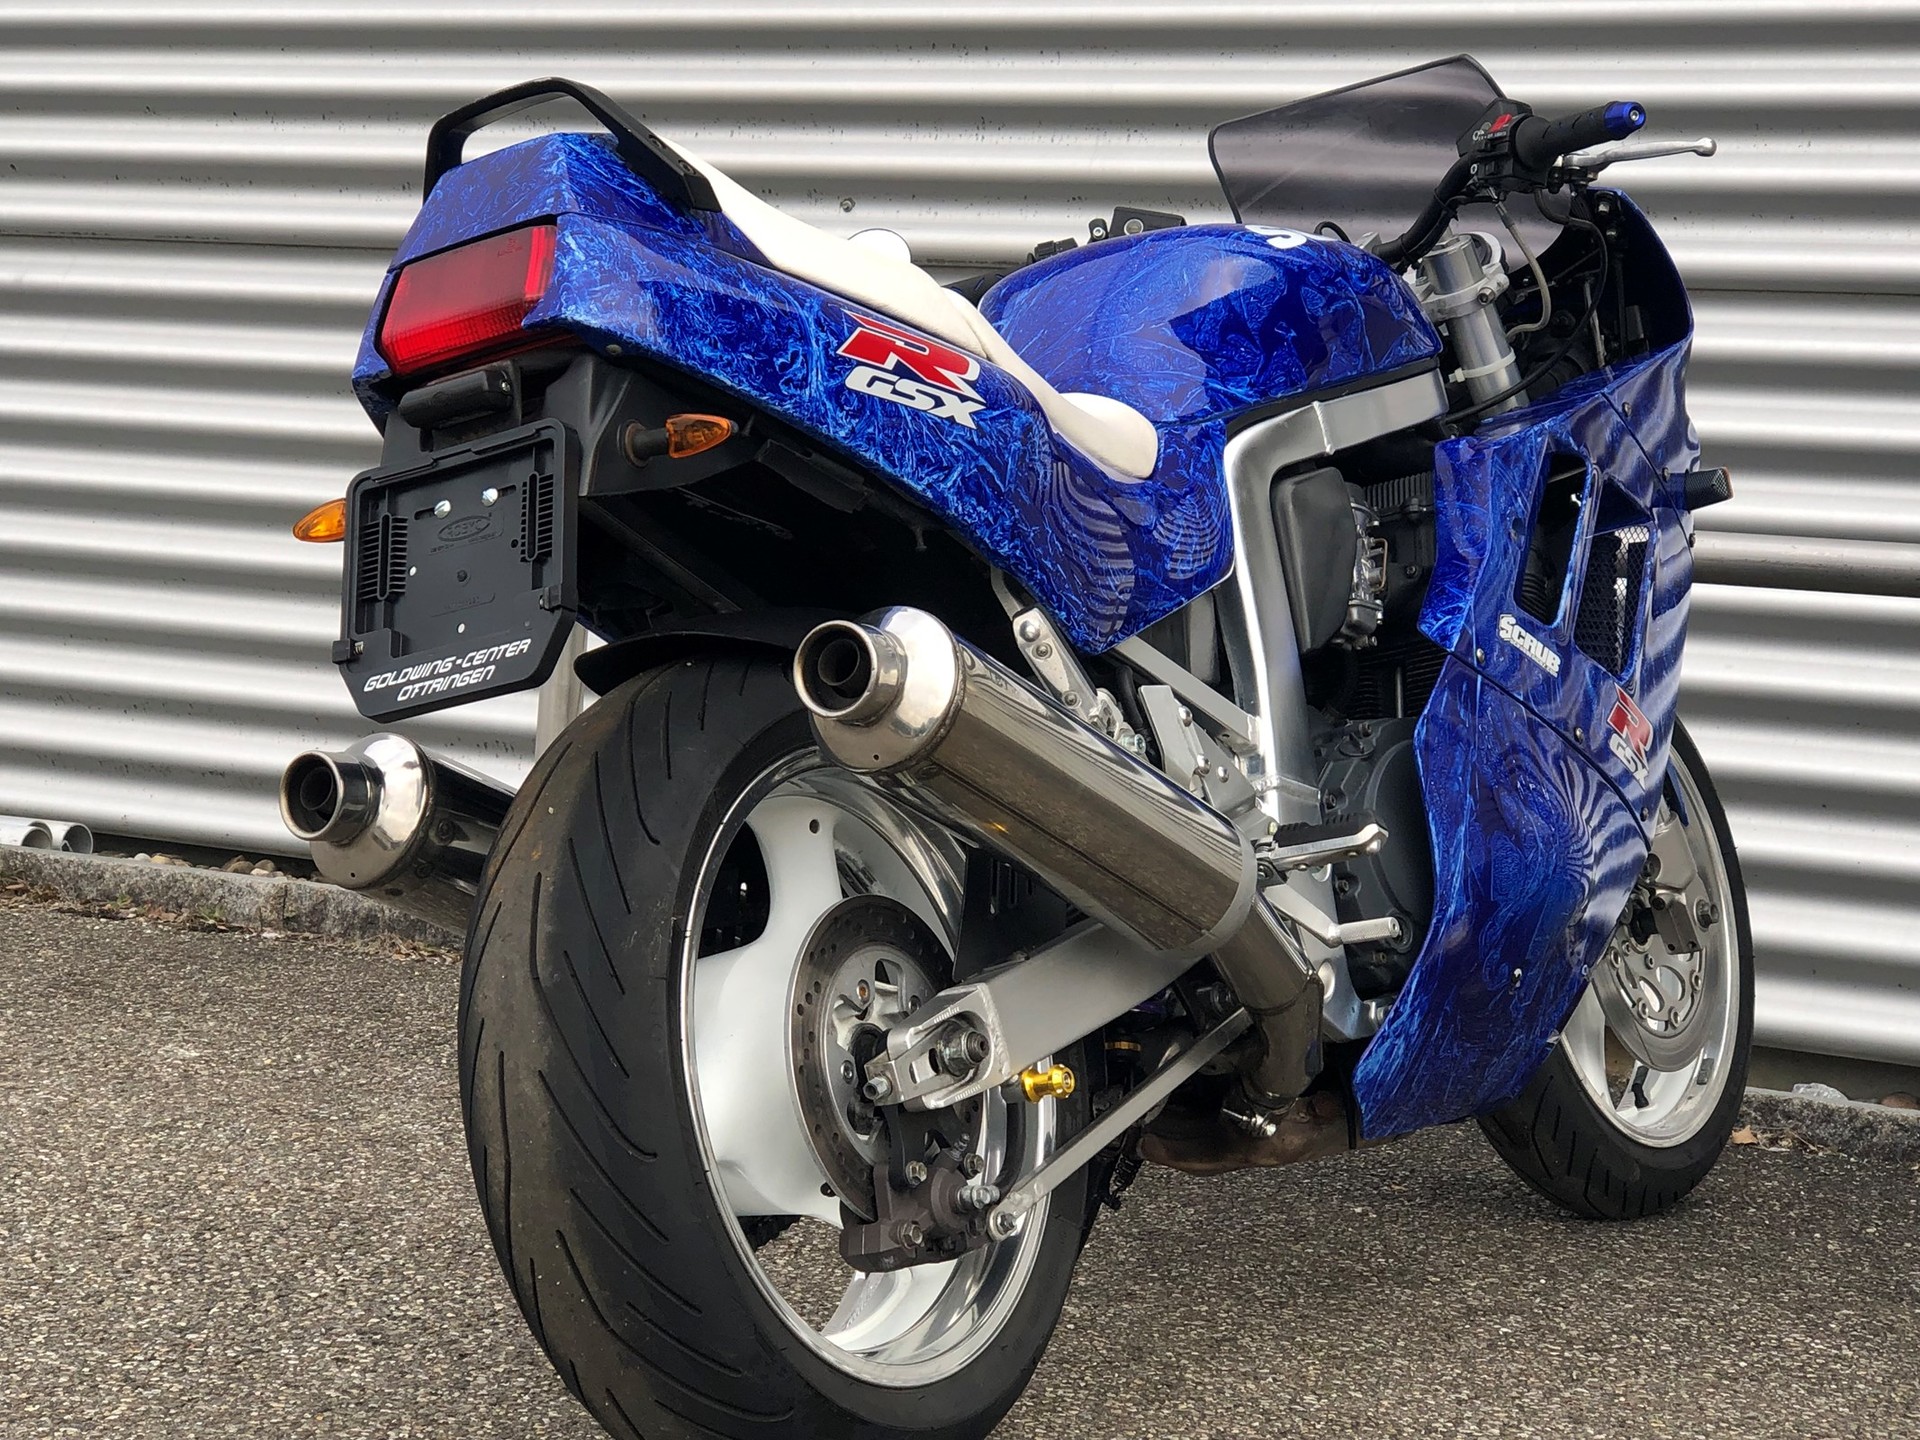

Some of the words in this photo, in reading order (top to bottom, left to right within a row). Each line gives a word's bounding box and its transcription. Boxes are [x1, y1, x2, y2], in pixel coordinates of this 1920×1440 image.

[836, 308, 987, 404] R
[845, 365, 987, 430] GSX
[363, 638, 532, 692] GOLDWING-CENTER
[1499, 613, 1561, 673] SCRUB
[397, 665, 496, 702] OFTRINGEN
[1607, 682, 1654, 774] R
[1609, 732, 1650, 795] GSX
